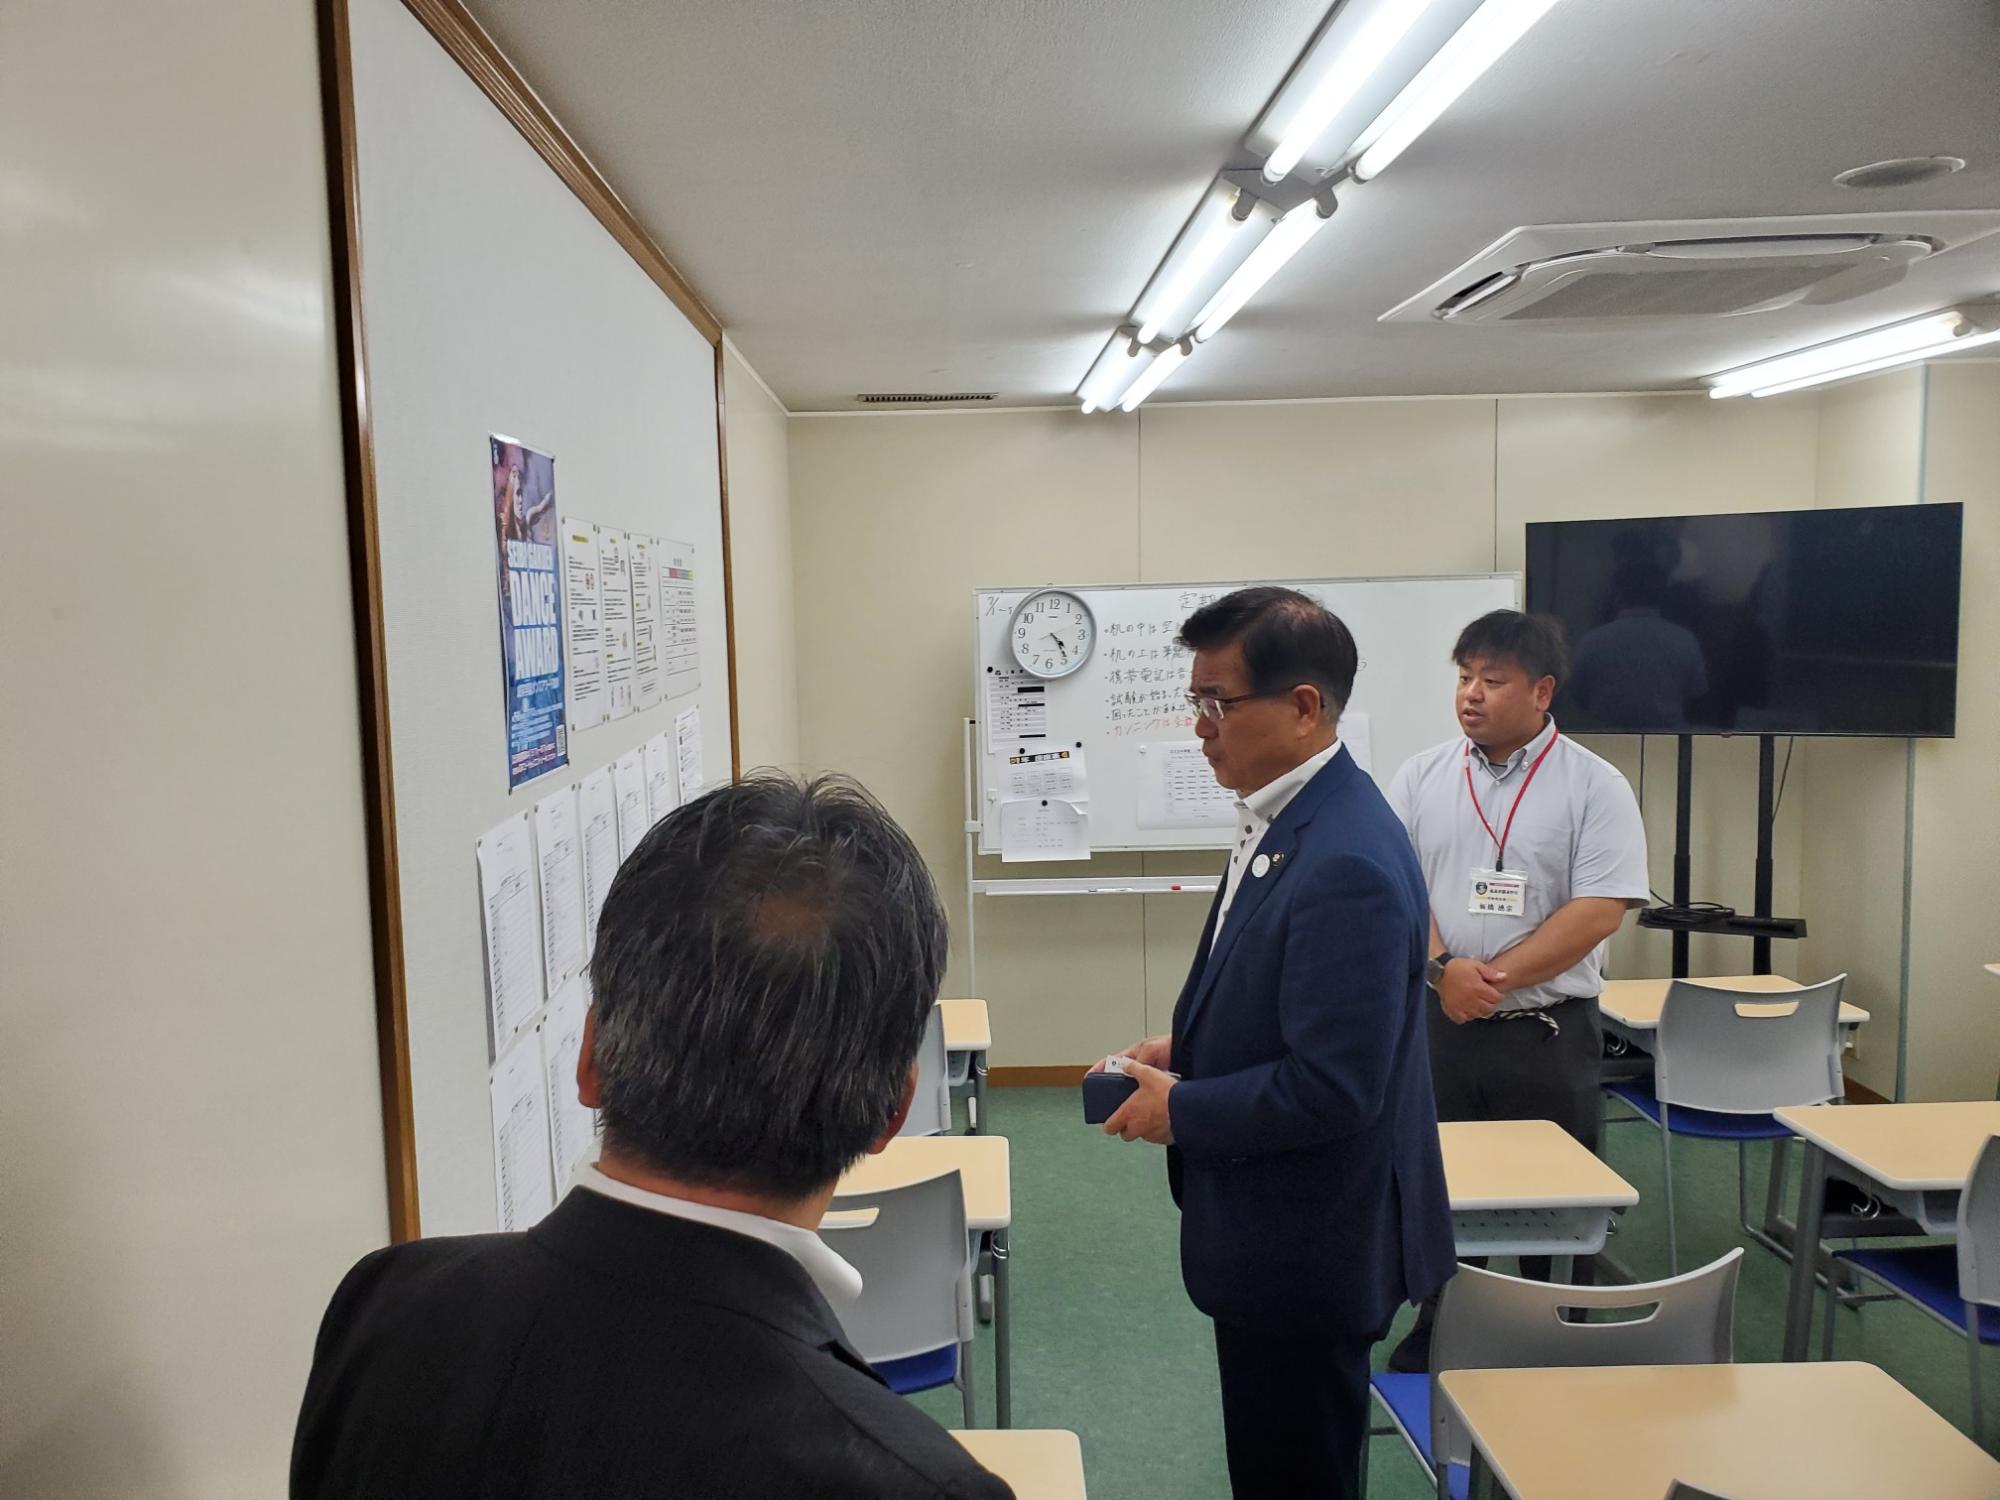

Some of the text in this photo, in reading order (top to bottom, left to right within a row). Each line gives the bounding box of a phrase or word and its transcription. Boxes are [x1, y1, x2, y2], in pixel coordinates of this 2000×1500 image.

[509, 570, 557, 627] DANCE
[1048, 598, 1061, 610] 12
[1034, 602, 1045, 613] 11
[1023, 612, 1034, 624] 10
[1074, 613, 1082, 625] 2
[1017, 627, 1026, 639] 9
[1077, 629, 1086, 640] 3
[513, 627, 559, 680] AWARD
[1021, 643, 1030, 655] 8
[1072, 644, 1079, 656] 4
[1032, 654, 1040, 665] 7
[1045, 658, 1054, 669] 6
